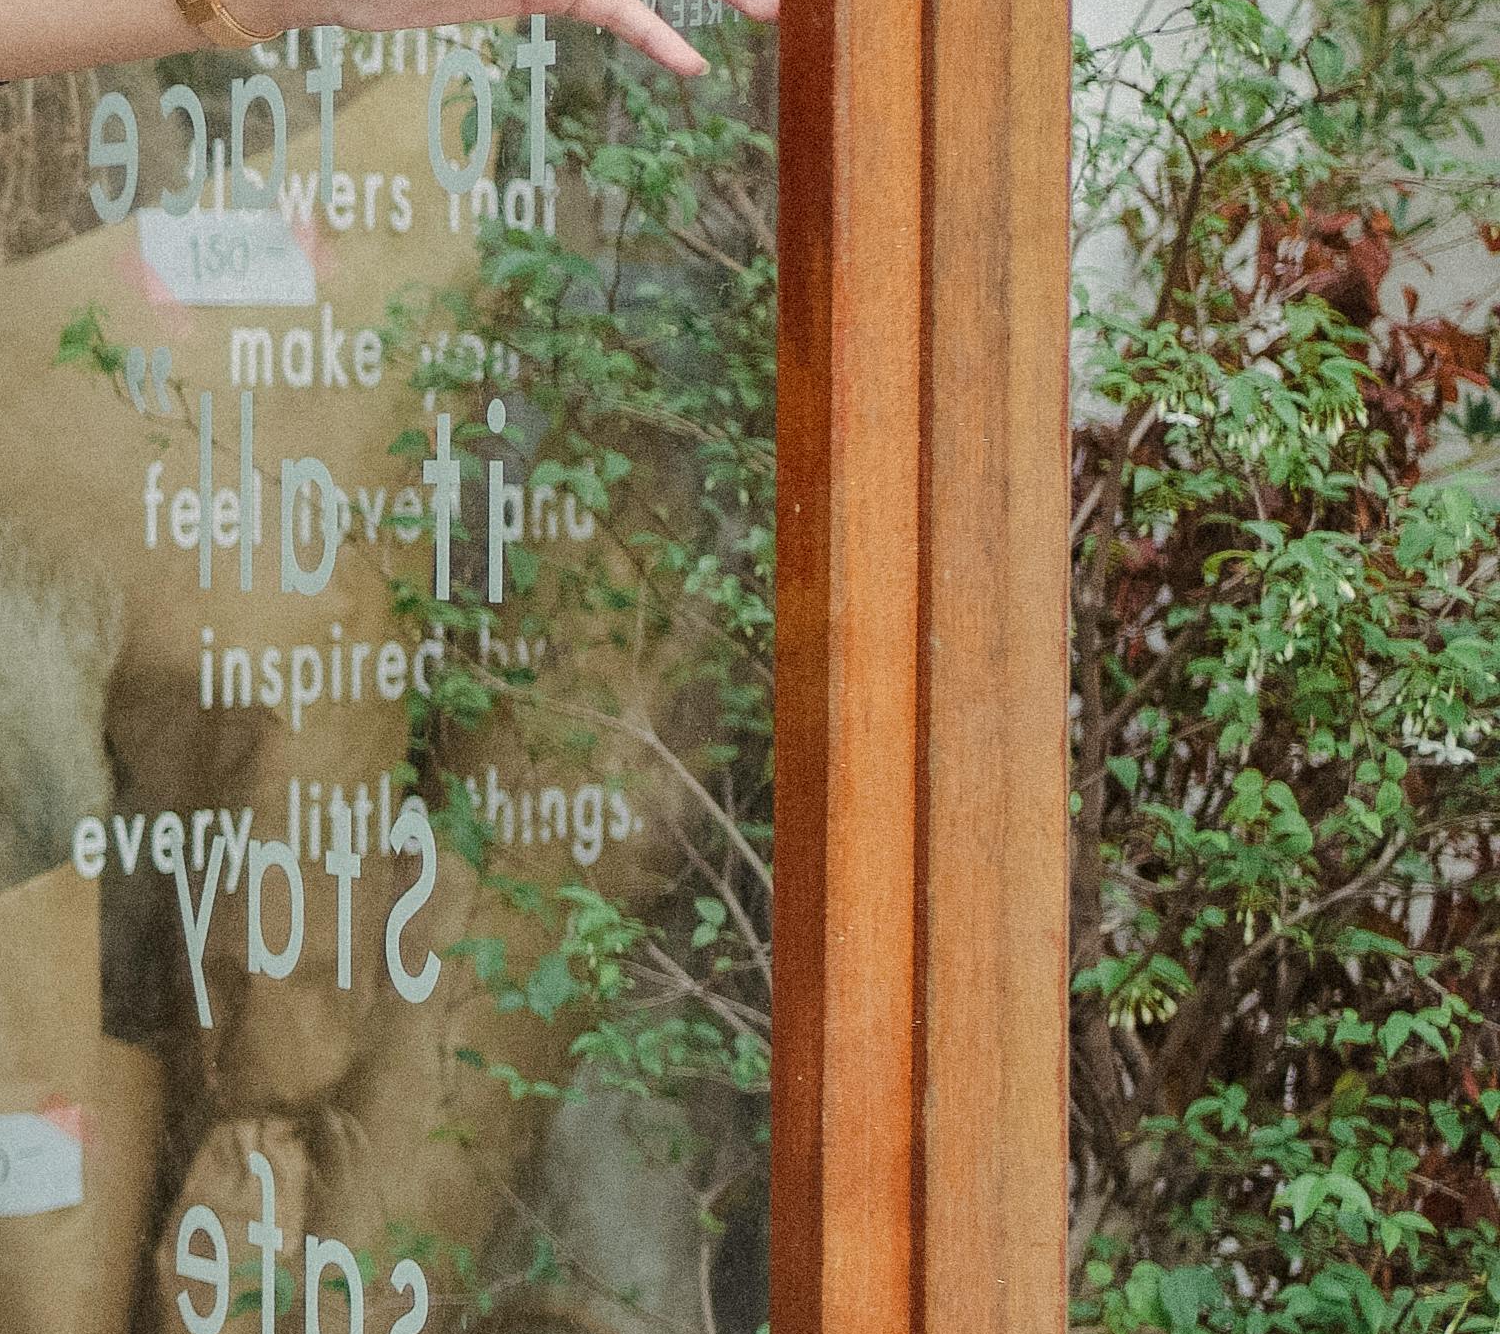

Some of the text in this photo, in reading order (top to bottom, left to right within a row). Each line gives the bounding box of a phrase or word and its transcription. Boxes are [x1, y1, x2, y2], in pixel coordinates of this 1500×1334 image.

[184, 138, 413, 233] lwers
[229, 302, 384, 389] make
[143, 459, 263, 550] feel
[199, 621, 447, 733] inspired
[72, 806, 254, 895] every
[468, 764, 644, 866] hings.
